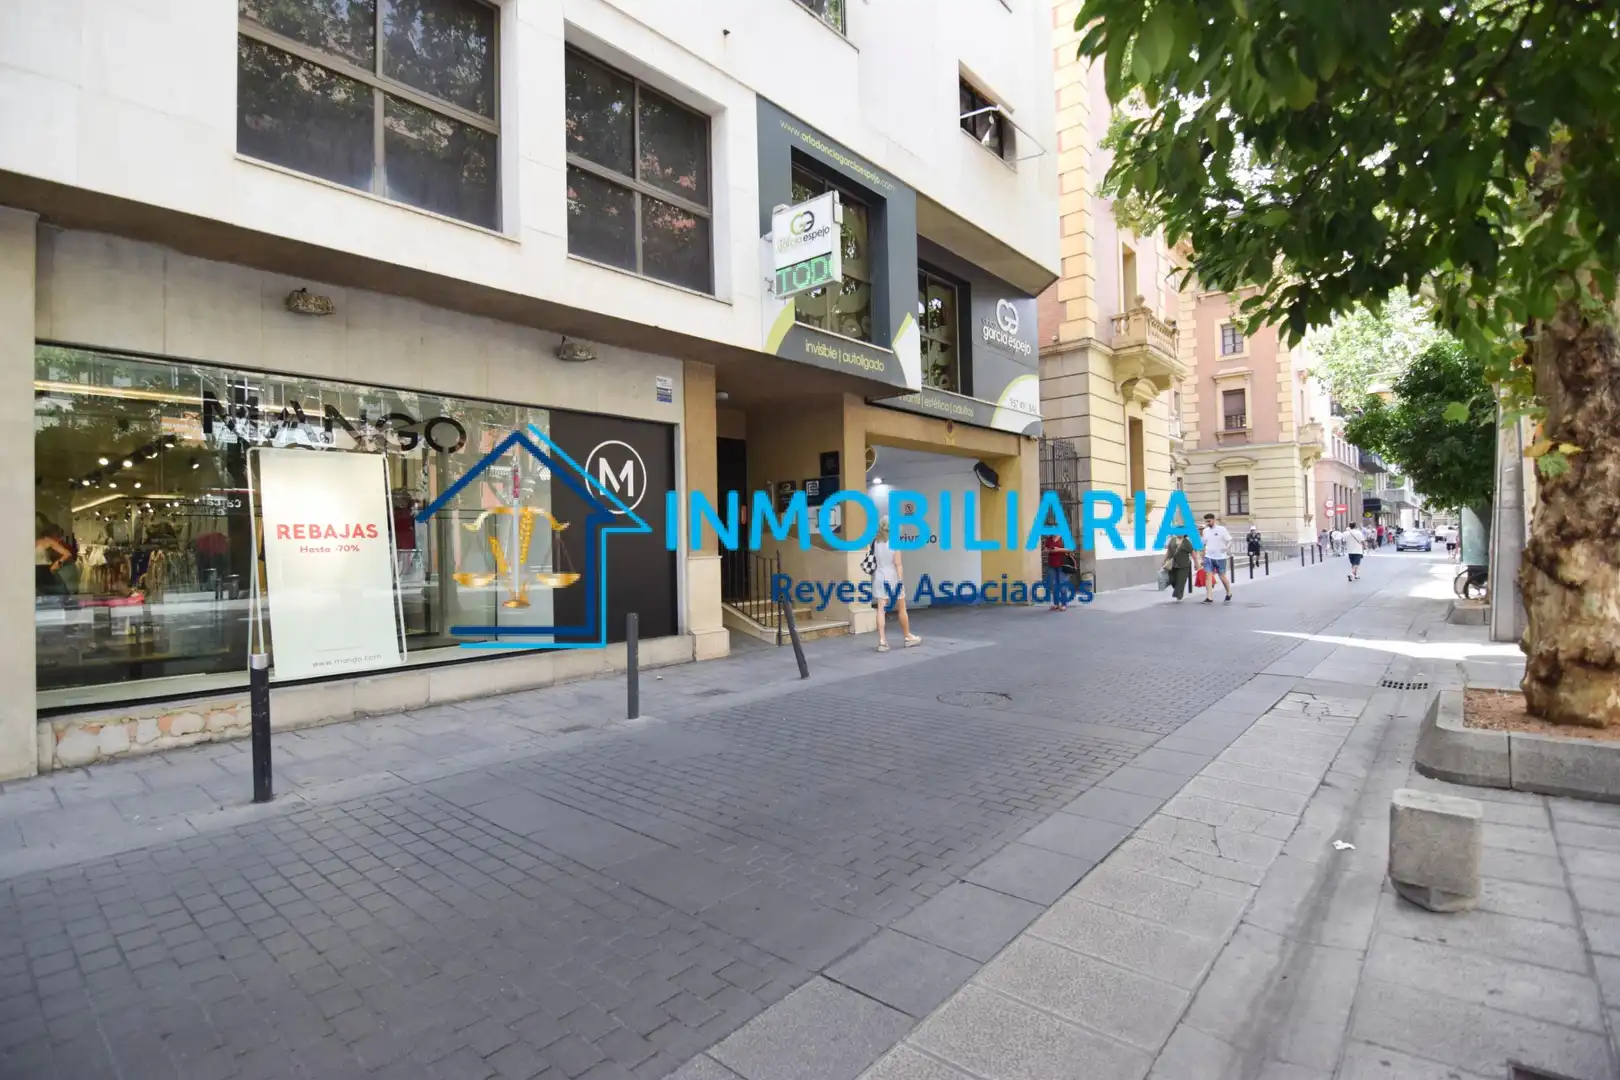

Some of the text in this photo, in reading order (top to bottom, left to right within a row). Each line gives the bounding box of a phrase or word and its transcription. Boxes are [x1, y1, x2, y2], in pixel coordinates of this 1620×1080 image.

[803, 225, 830, 242] espejo
[1008, 336, 1031, 356] espejo
[805, 338, 885, 372] invisible autoligado
[276, 523, 379, 540] REBAJAS
[300, 544, 360, 553] Hasta -70%
[311, 654, 382, 668] www.mango.com
